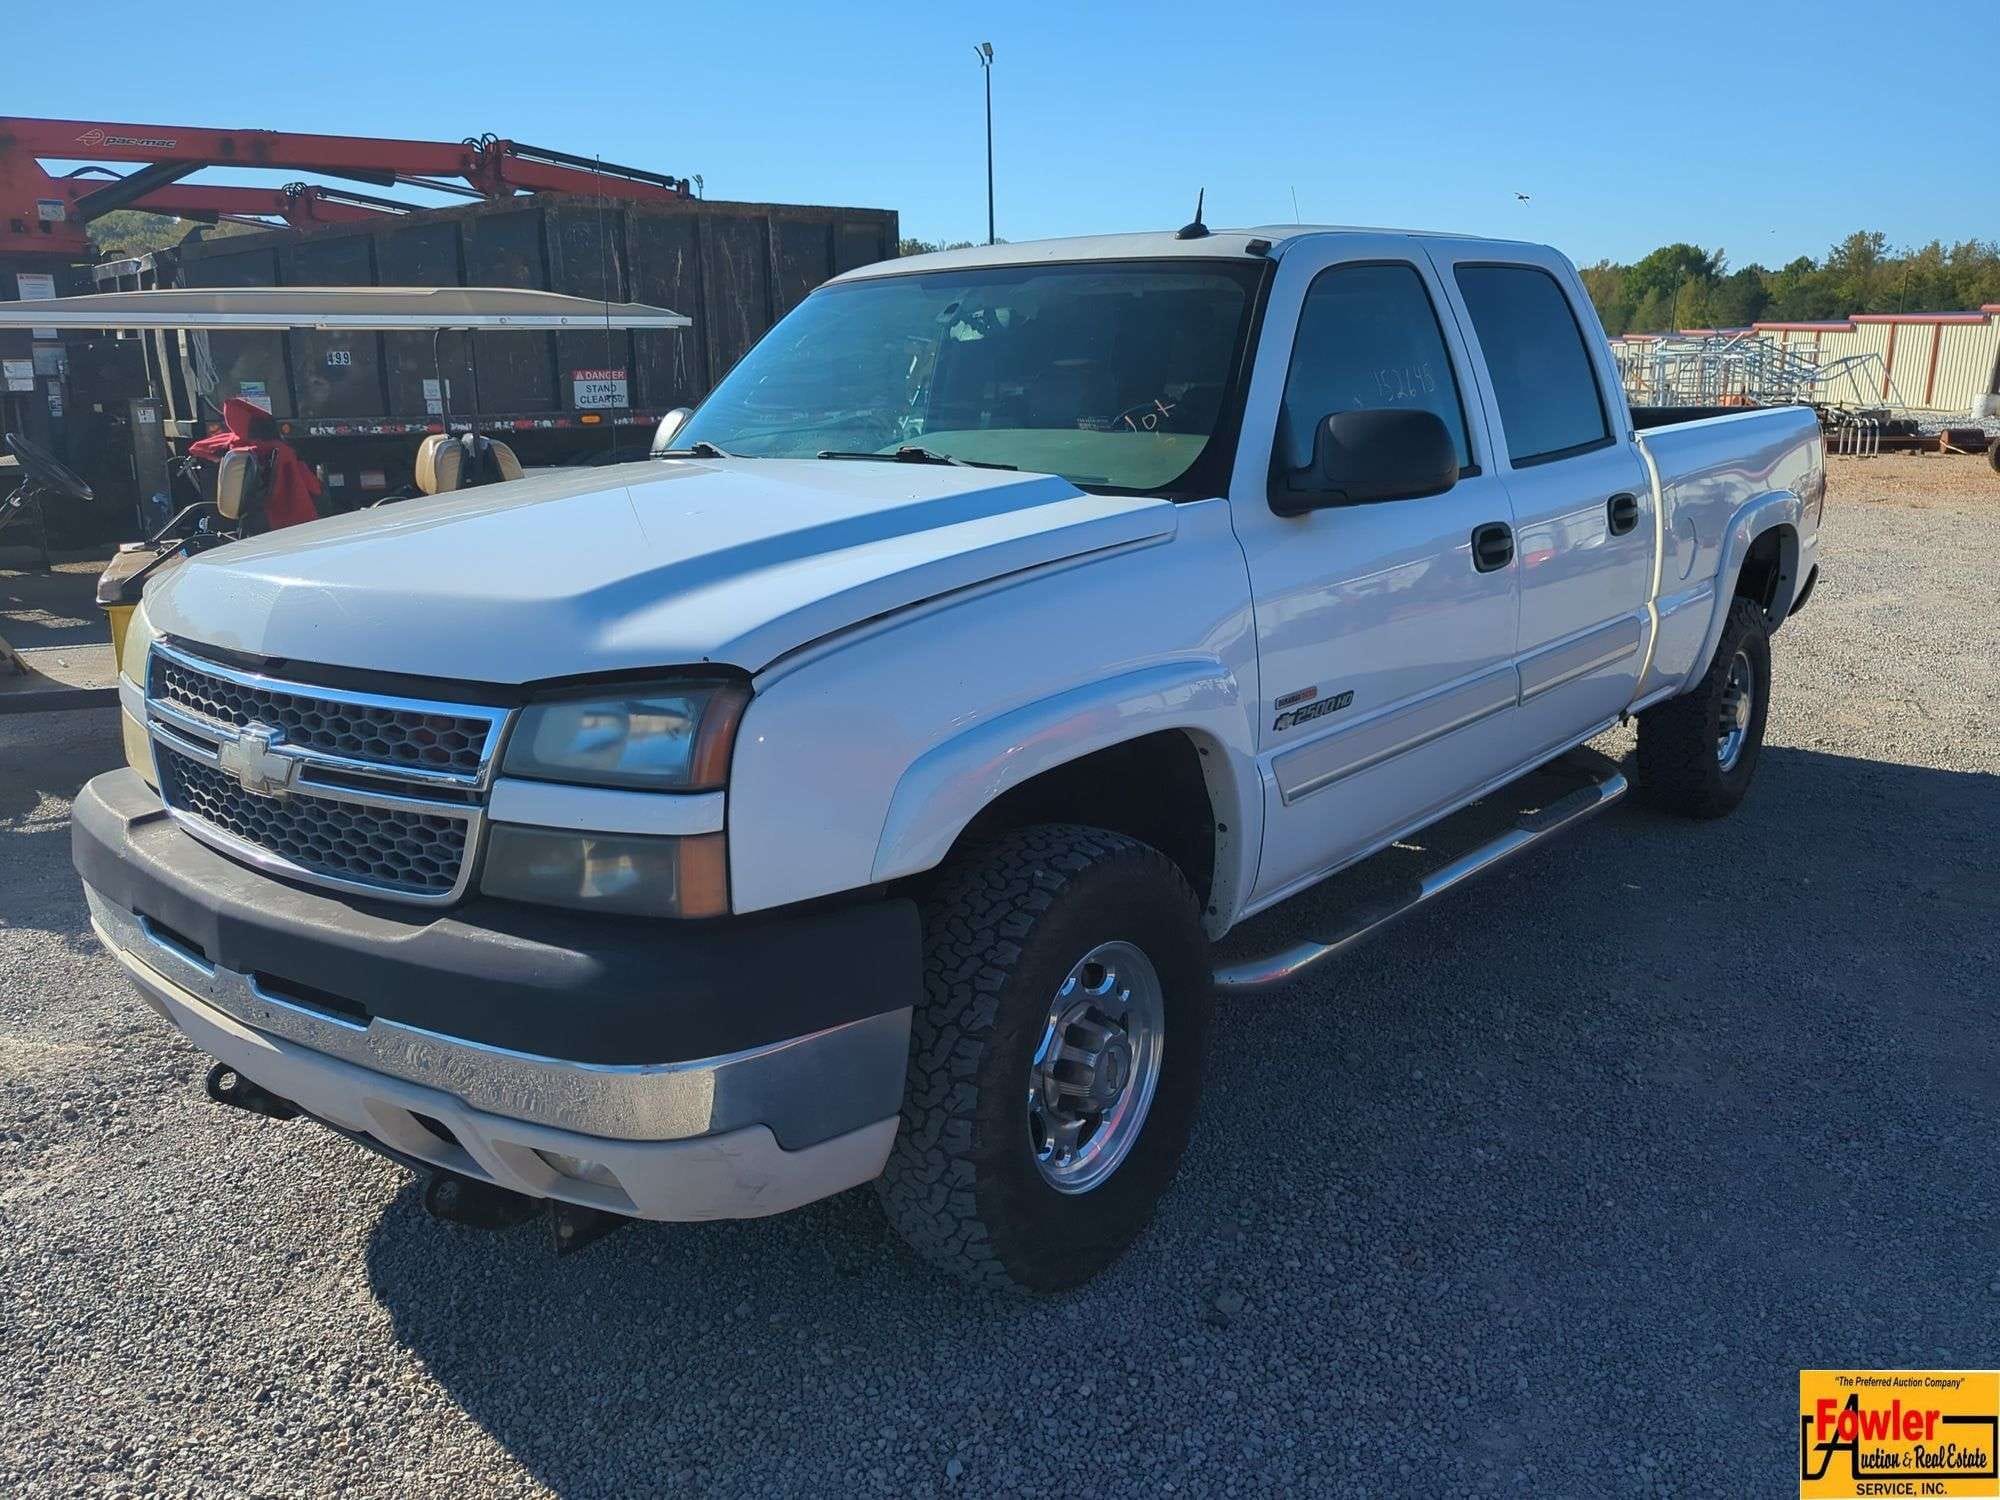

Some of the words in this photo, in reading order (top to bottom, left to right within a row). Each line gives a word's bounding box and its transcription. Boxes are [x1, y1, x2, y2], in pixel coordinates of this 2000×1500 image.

[585, 371, 624, 380] DANGER
[586, 384, 617, 393] STAND
[580, 395, 610, 404] CLEAR
